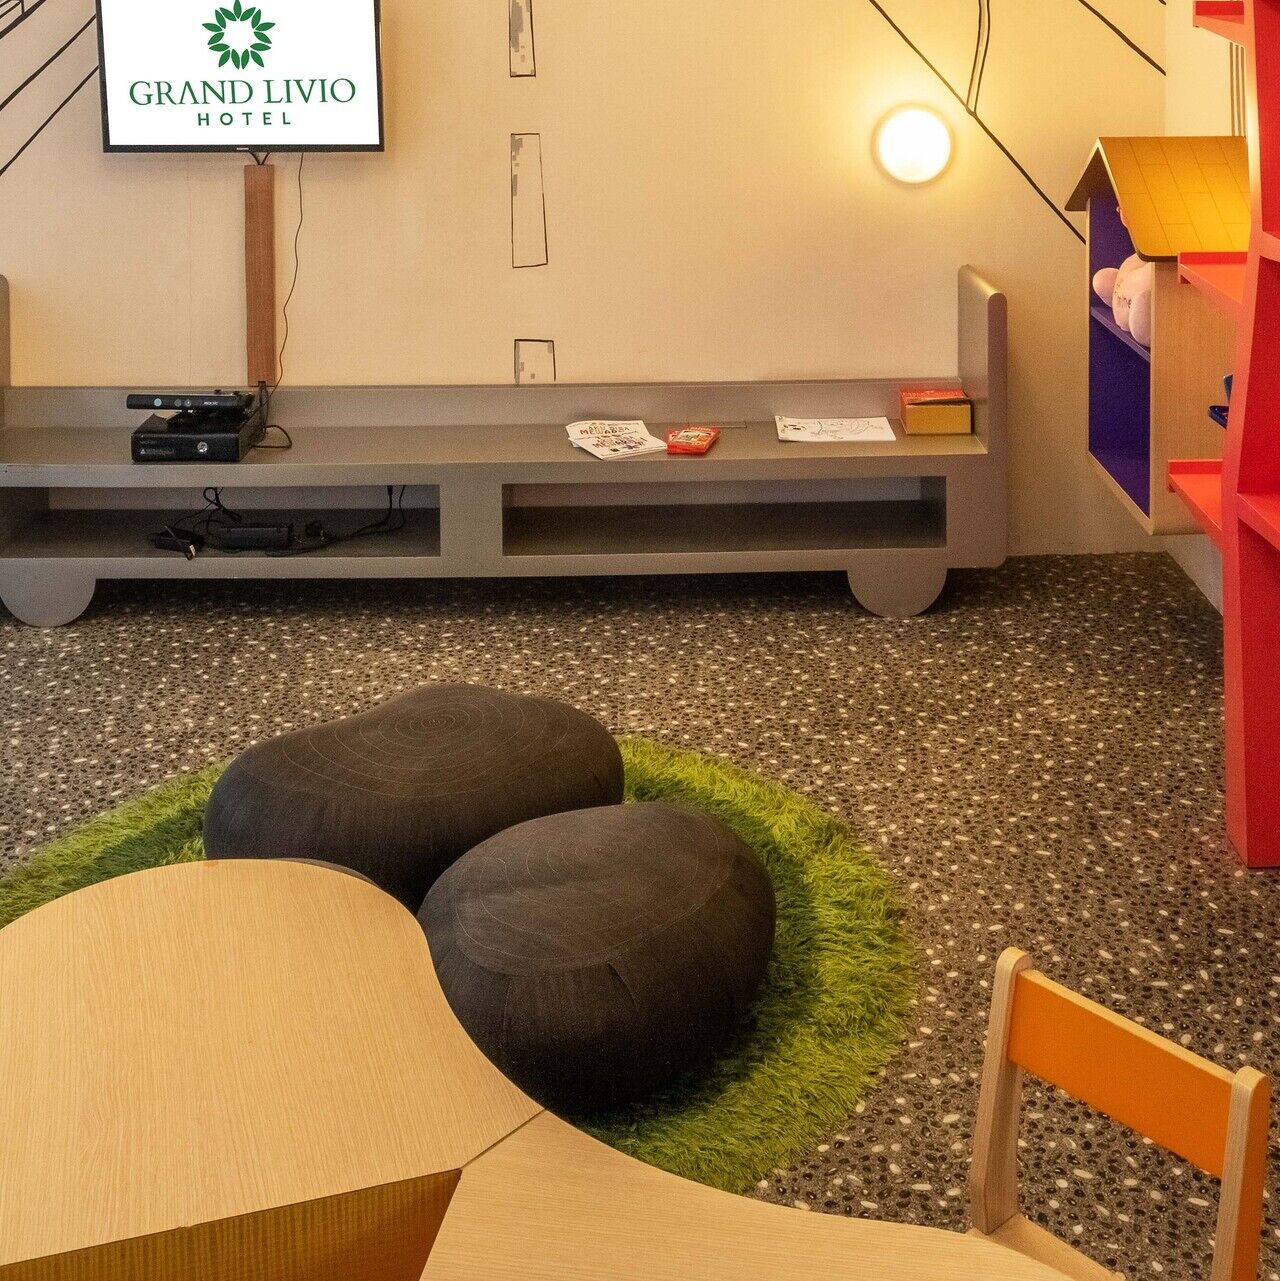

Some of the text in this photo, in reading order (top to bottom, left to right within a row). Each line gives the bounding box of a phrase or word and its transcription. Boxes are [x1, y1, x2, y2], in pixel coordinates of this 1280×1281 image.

[129, 77, 356, 106] GRAND LIVIO
[197, 111, 291, 126] HOTEL
